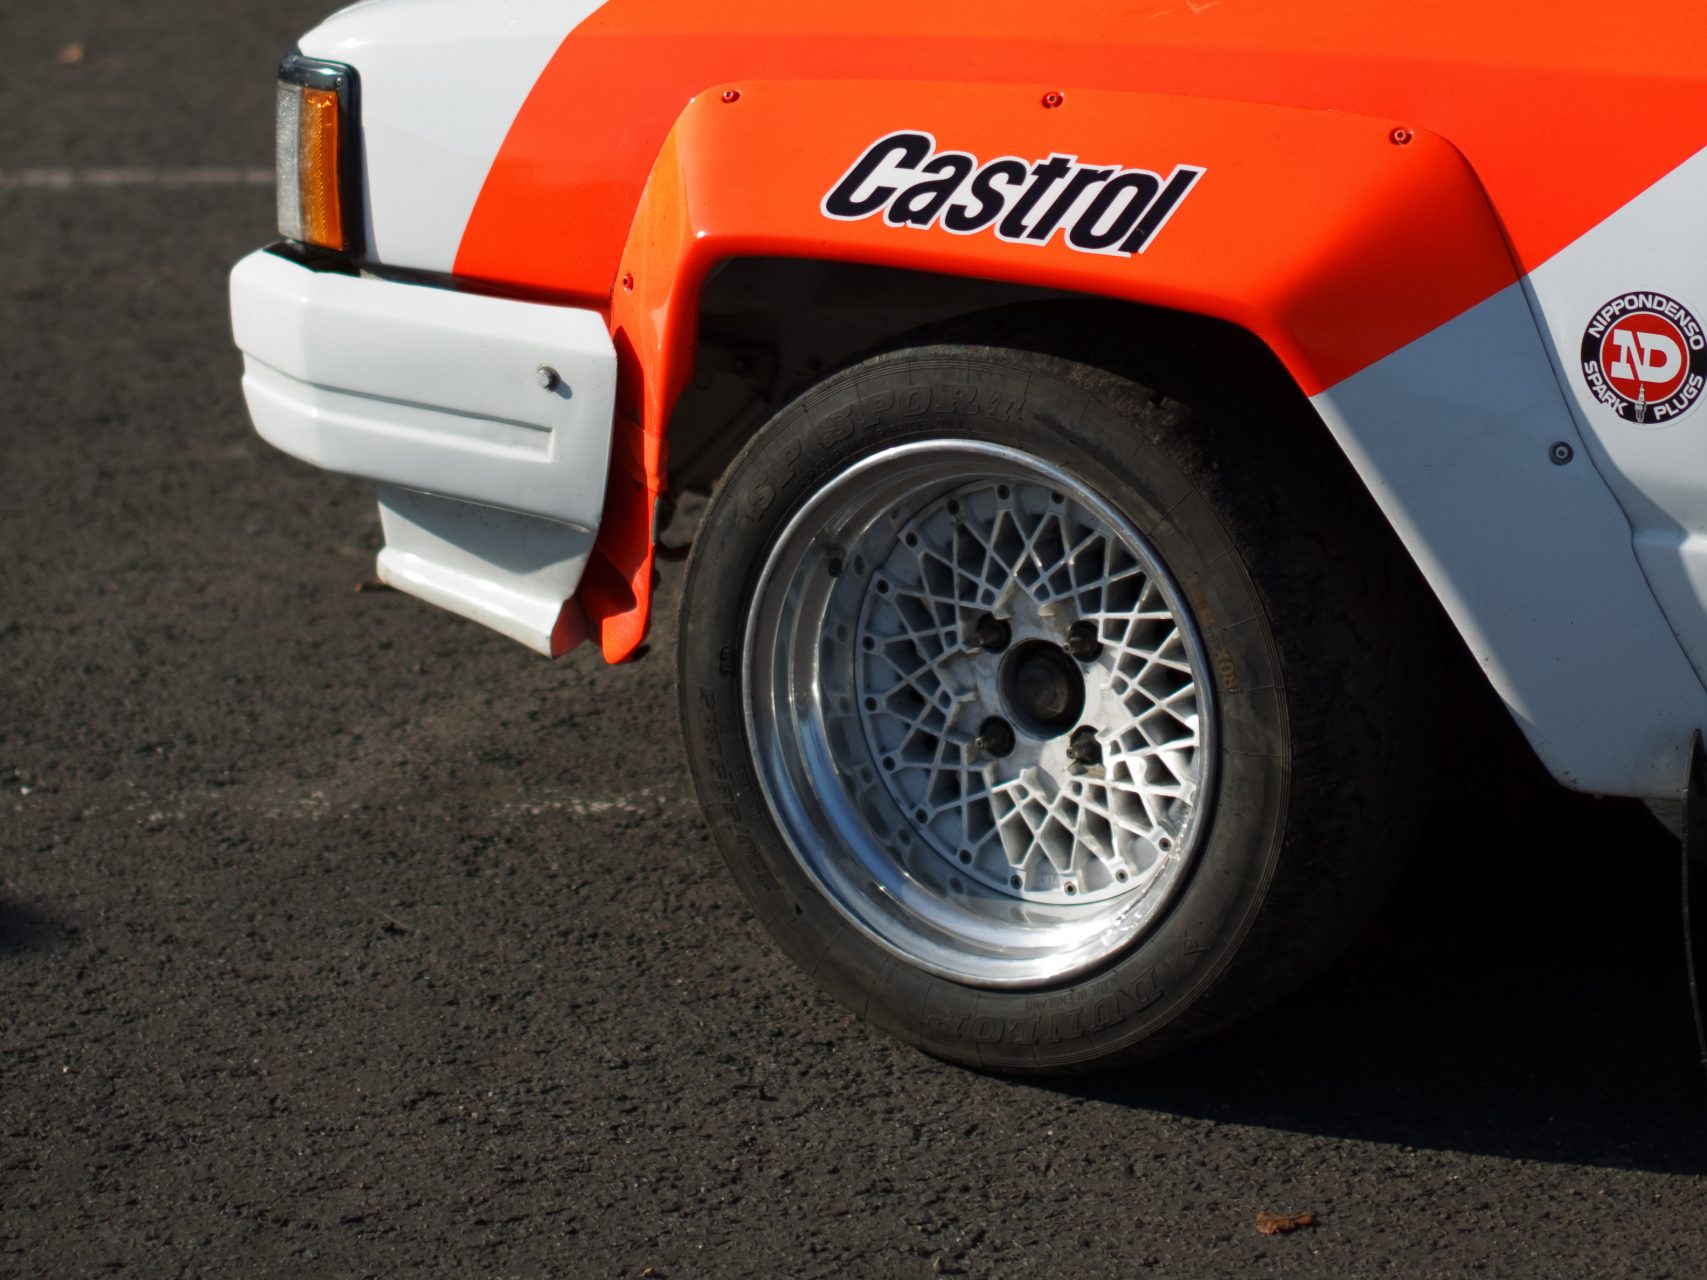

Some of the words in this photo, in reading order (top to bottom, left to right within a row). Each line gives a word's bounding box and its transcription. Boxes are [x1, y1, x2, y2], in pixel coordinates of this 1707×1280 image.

[822, 131, 1204, 256] Castrol
[1587, 293, 1705, 352] NIPPONDENSO
[822, 384, 1028, 448] SPORT
[1583, 359, 1628, 417] SPARK
[1653, 372, 1704, 420] PLUGS
[926, 967, 1164, 1045] DUNLOP
